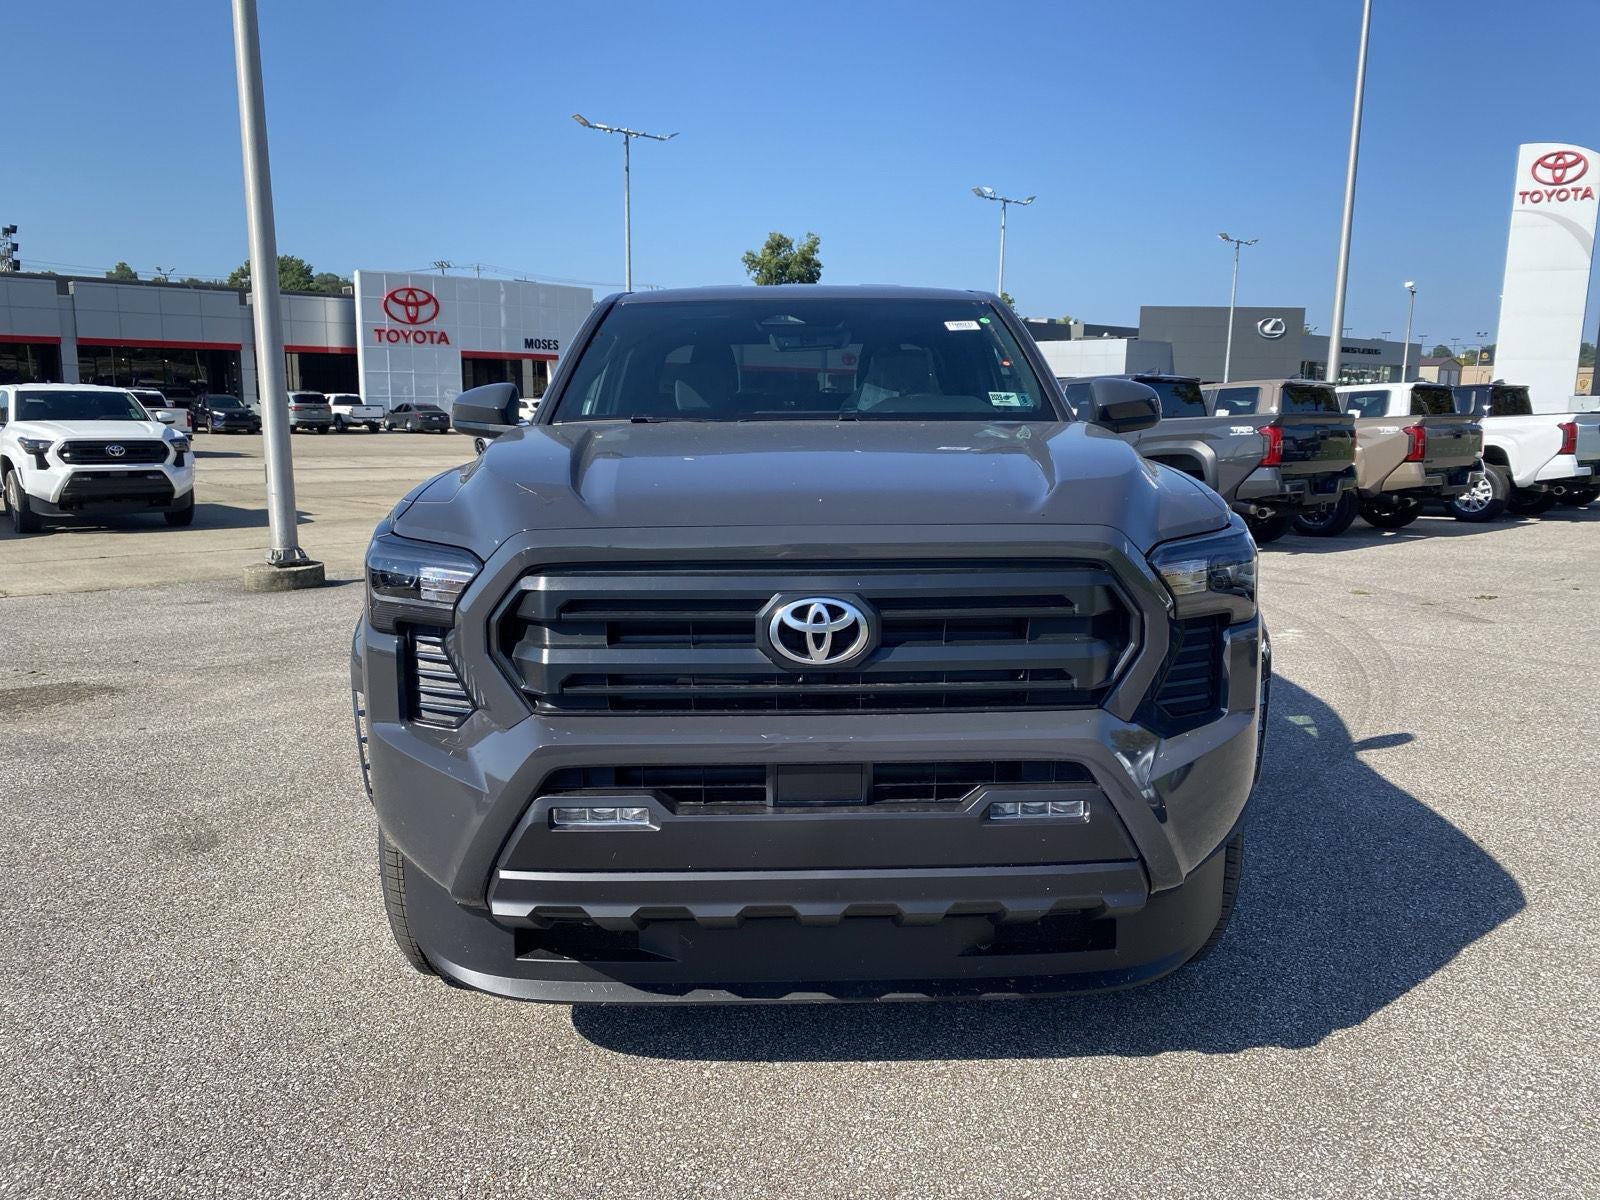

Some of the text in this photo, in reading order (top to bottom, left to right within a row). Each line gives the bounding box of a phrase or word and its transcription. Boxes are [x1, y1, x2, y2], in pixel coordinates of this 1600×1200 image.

[1519, 186, 1595, 204] TOYOTA
[374, 328, 450, 345] TOYOTA
[524, 338, 559, 350] MOSES
